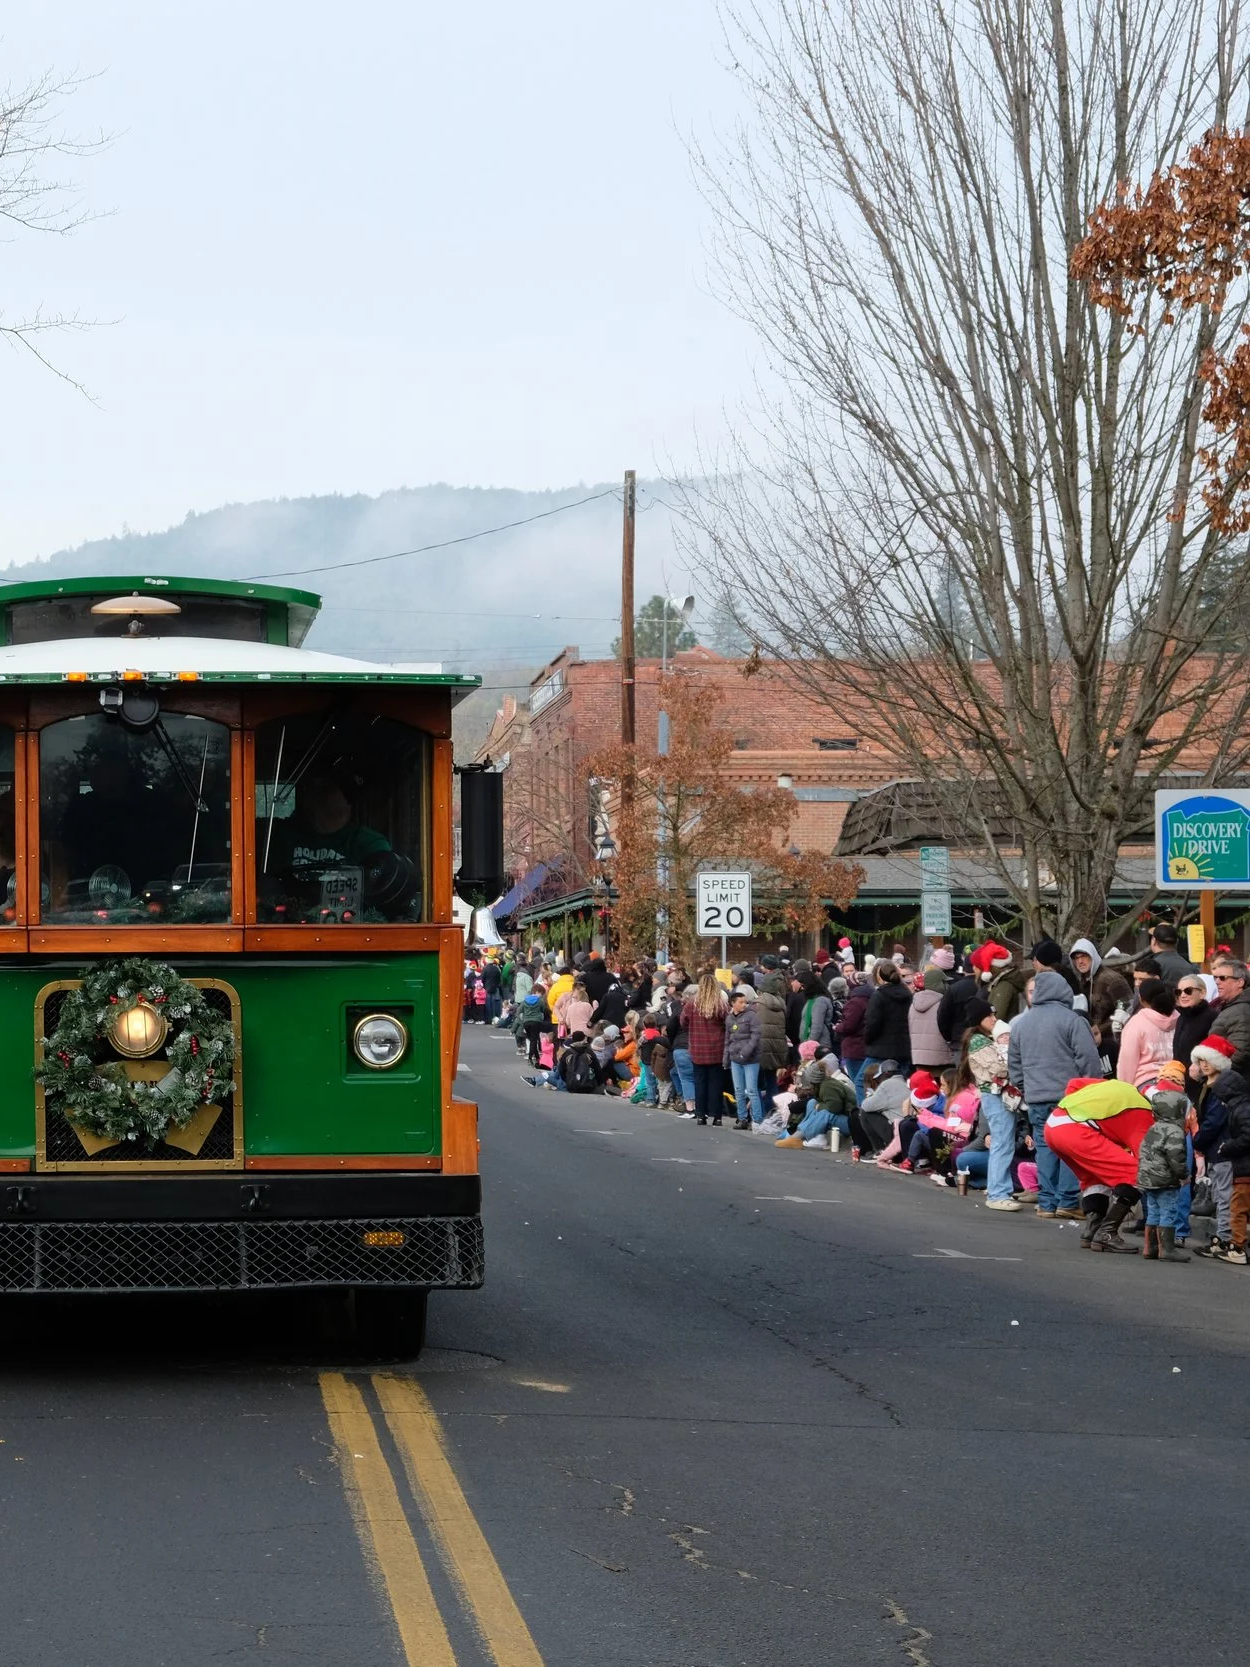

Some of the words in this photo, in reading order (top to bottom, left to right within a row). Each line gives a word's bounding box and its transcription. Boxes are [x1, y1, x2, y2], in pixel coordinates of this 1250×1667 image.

[1173, 822, 1243, 838] DISCOVERY
[293, 847, 346, 860] HOLIDAY
[1188, 840, 1230, 855] DRIVE
[703, 880, 745, 889] SPEED
[707, 893, 740, 902] LIMIT
[704, 906, 744, 928] 20
